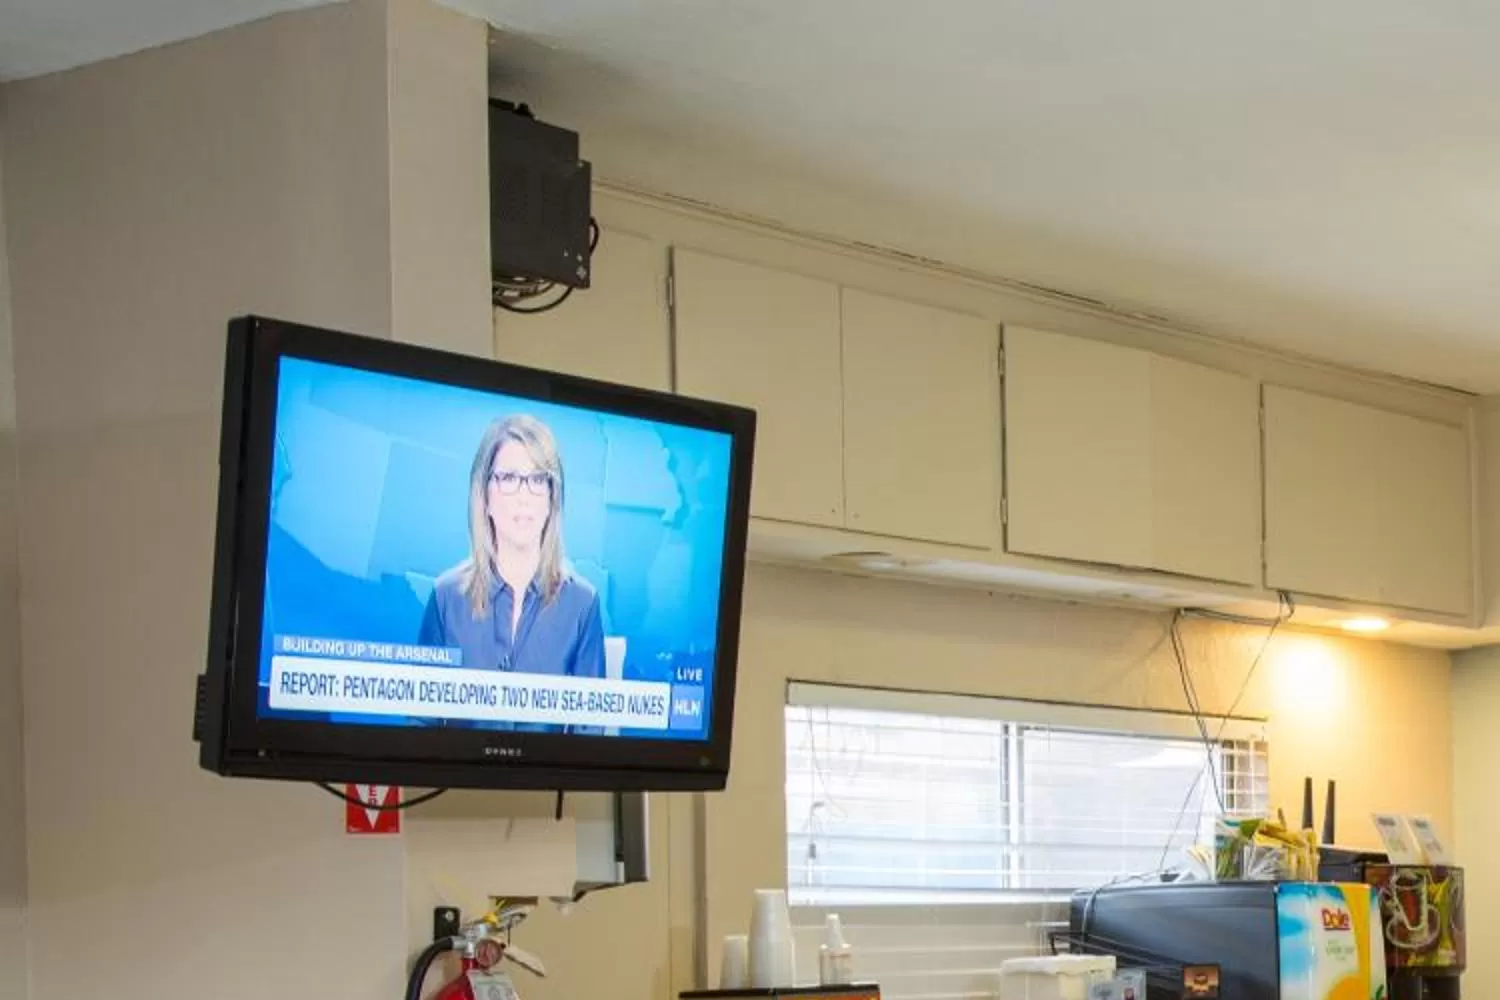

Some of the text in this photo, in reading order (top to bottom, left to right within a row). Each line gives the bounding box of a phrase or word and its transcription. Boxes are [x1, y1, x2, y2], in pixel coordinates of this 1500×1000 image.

[282, 636, 453, 662] BUILDING UP THE ARSENAL
[677, 667, 703, 682] LIVE
[280, 671, 665, 716] REPORT: PENTAGON DEVELOPING TWO NEW SEA-BASED NUKES
[675, 699, 701, 717] HLN
[1321, 907, 1350, 928] Dole
